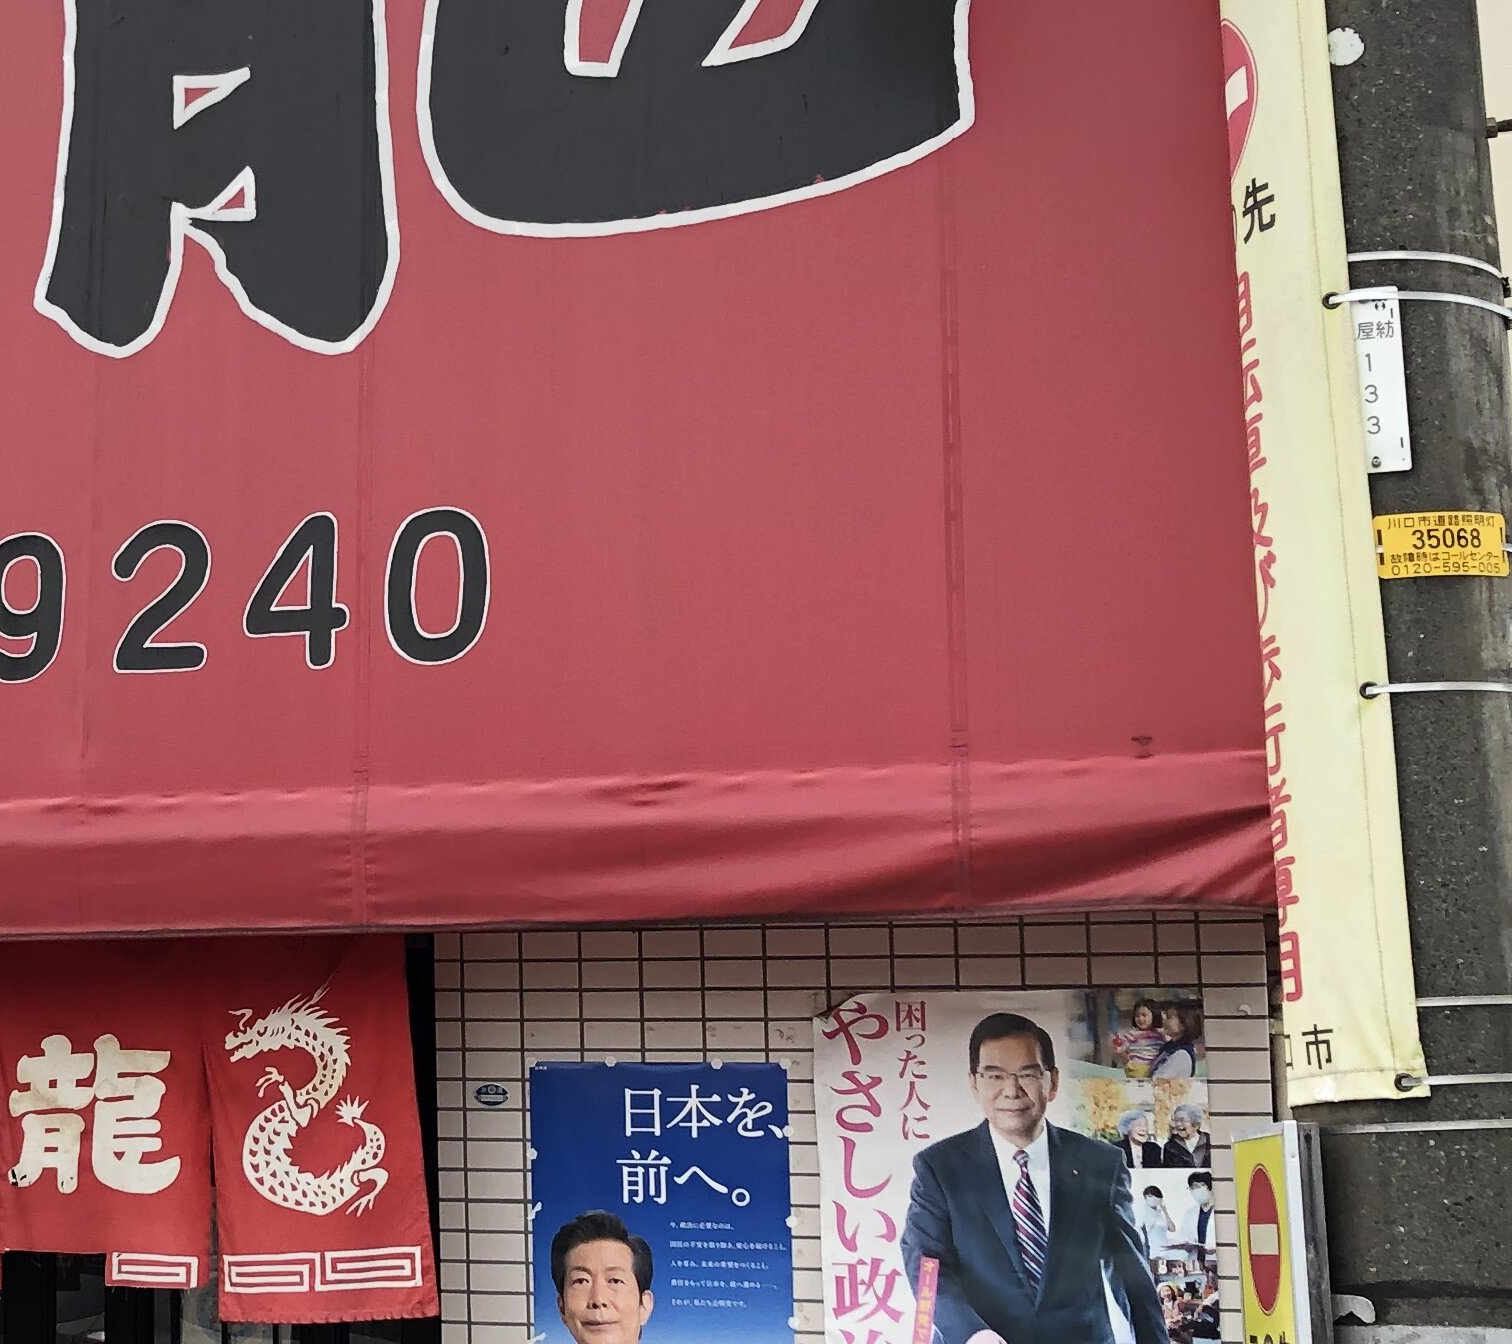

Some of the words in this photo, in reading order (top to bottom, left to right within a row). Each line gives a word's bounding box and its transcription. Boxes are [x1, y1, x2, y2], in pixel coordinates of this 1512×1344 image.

[1411, 528, 1482, 550] 35068
[893, 999, 931, 1141] 困った人に
[8, 1032, 180, 1195] 龍
[623, 1084, 789, 1140] 日本を、
[616, 1149, 752, 1207] 前へ。
